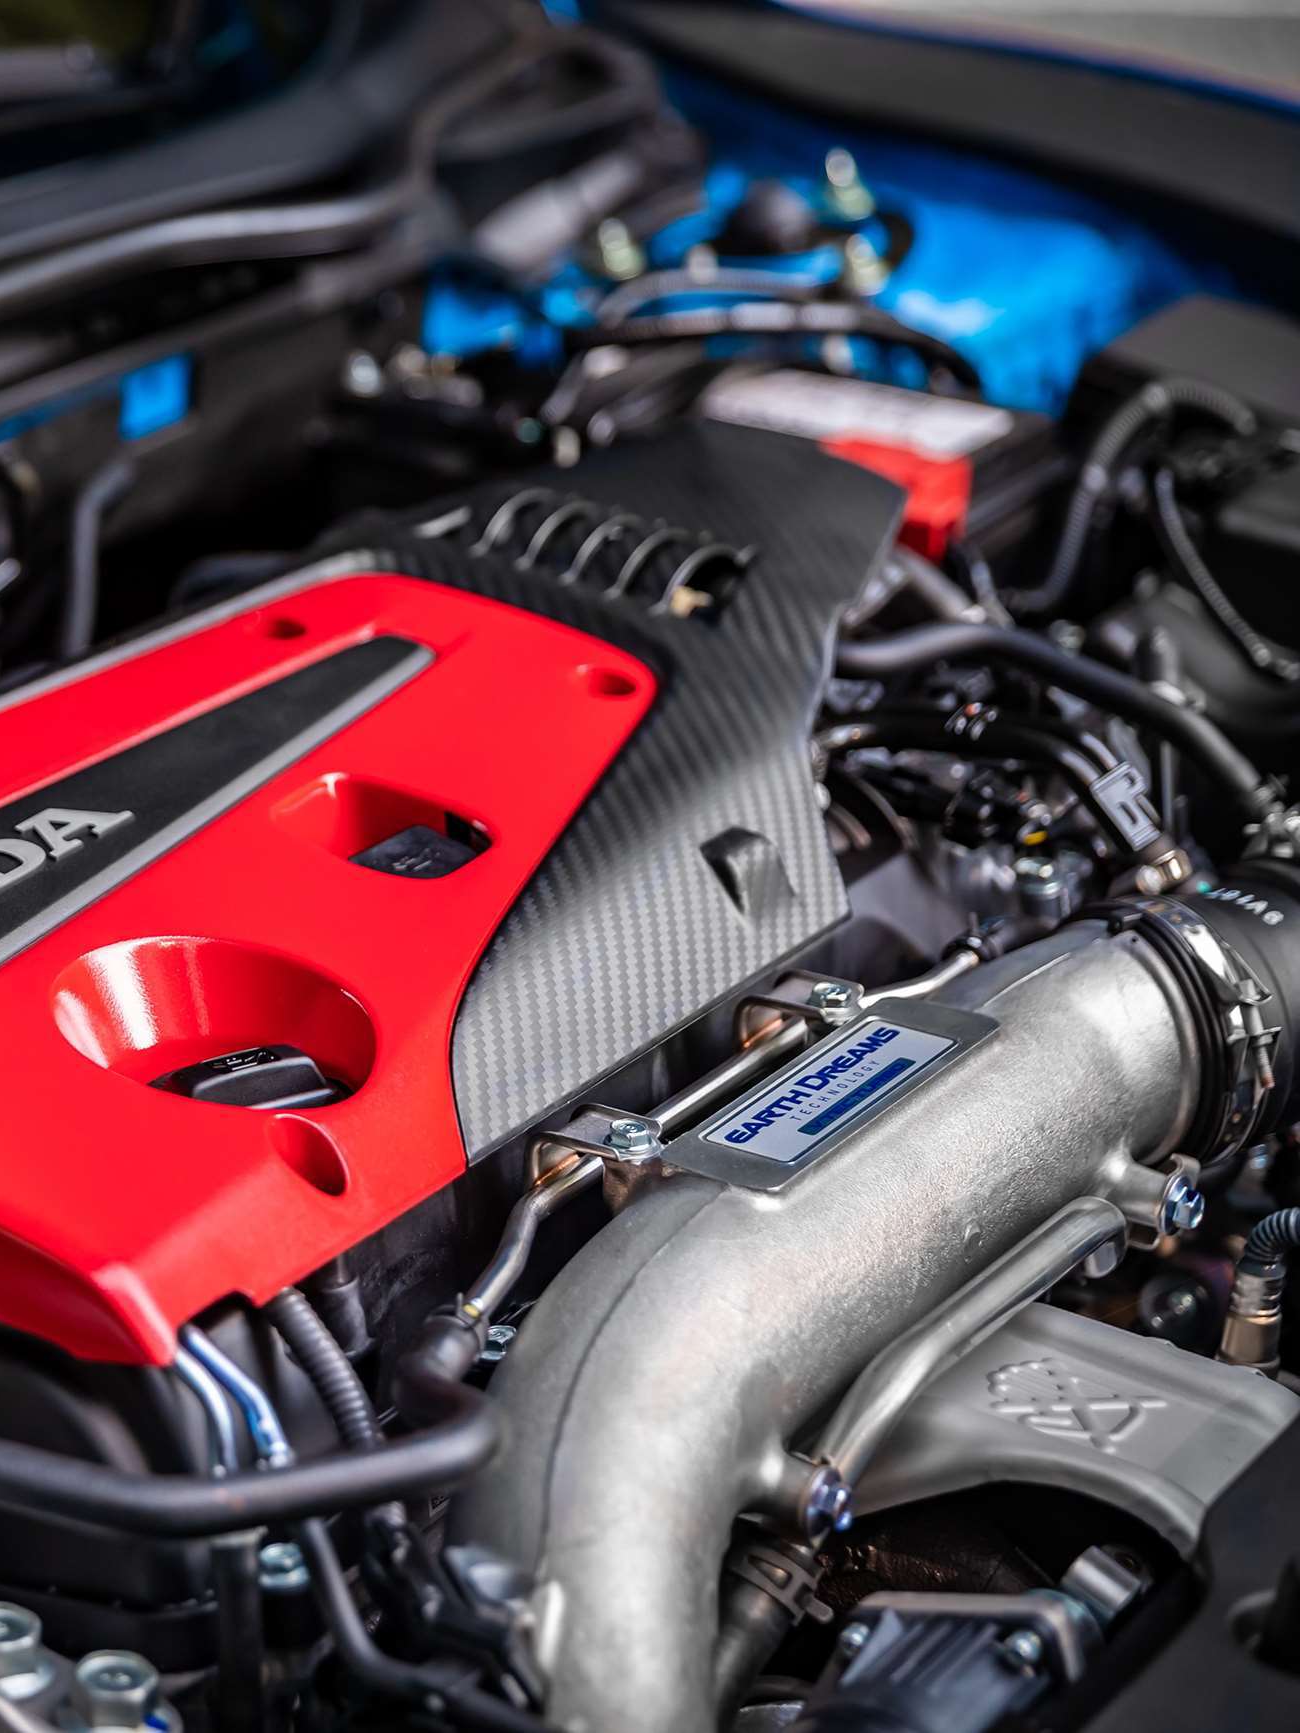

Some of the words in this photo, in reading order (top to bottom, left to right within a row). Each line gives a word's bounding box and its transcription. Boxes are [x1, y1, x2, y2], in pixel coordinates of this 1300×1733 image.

[724, 1092, 809, 1144] EARTH
[802, 1027, 901, 1092] DREAMS
[789, 1060, 882, 1121] TECHNOLOGY
